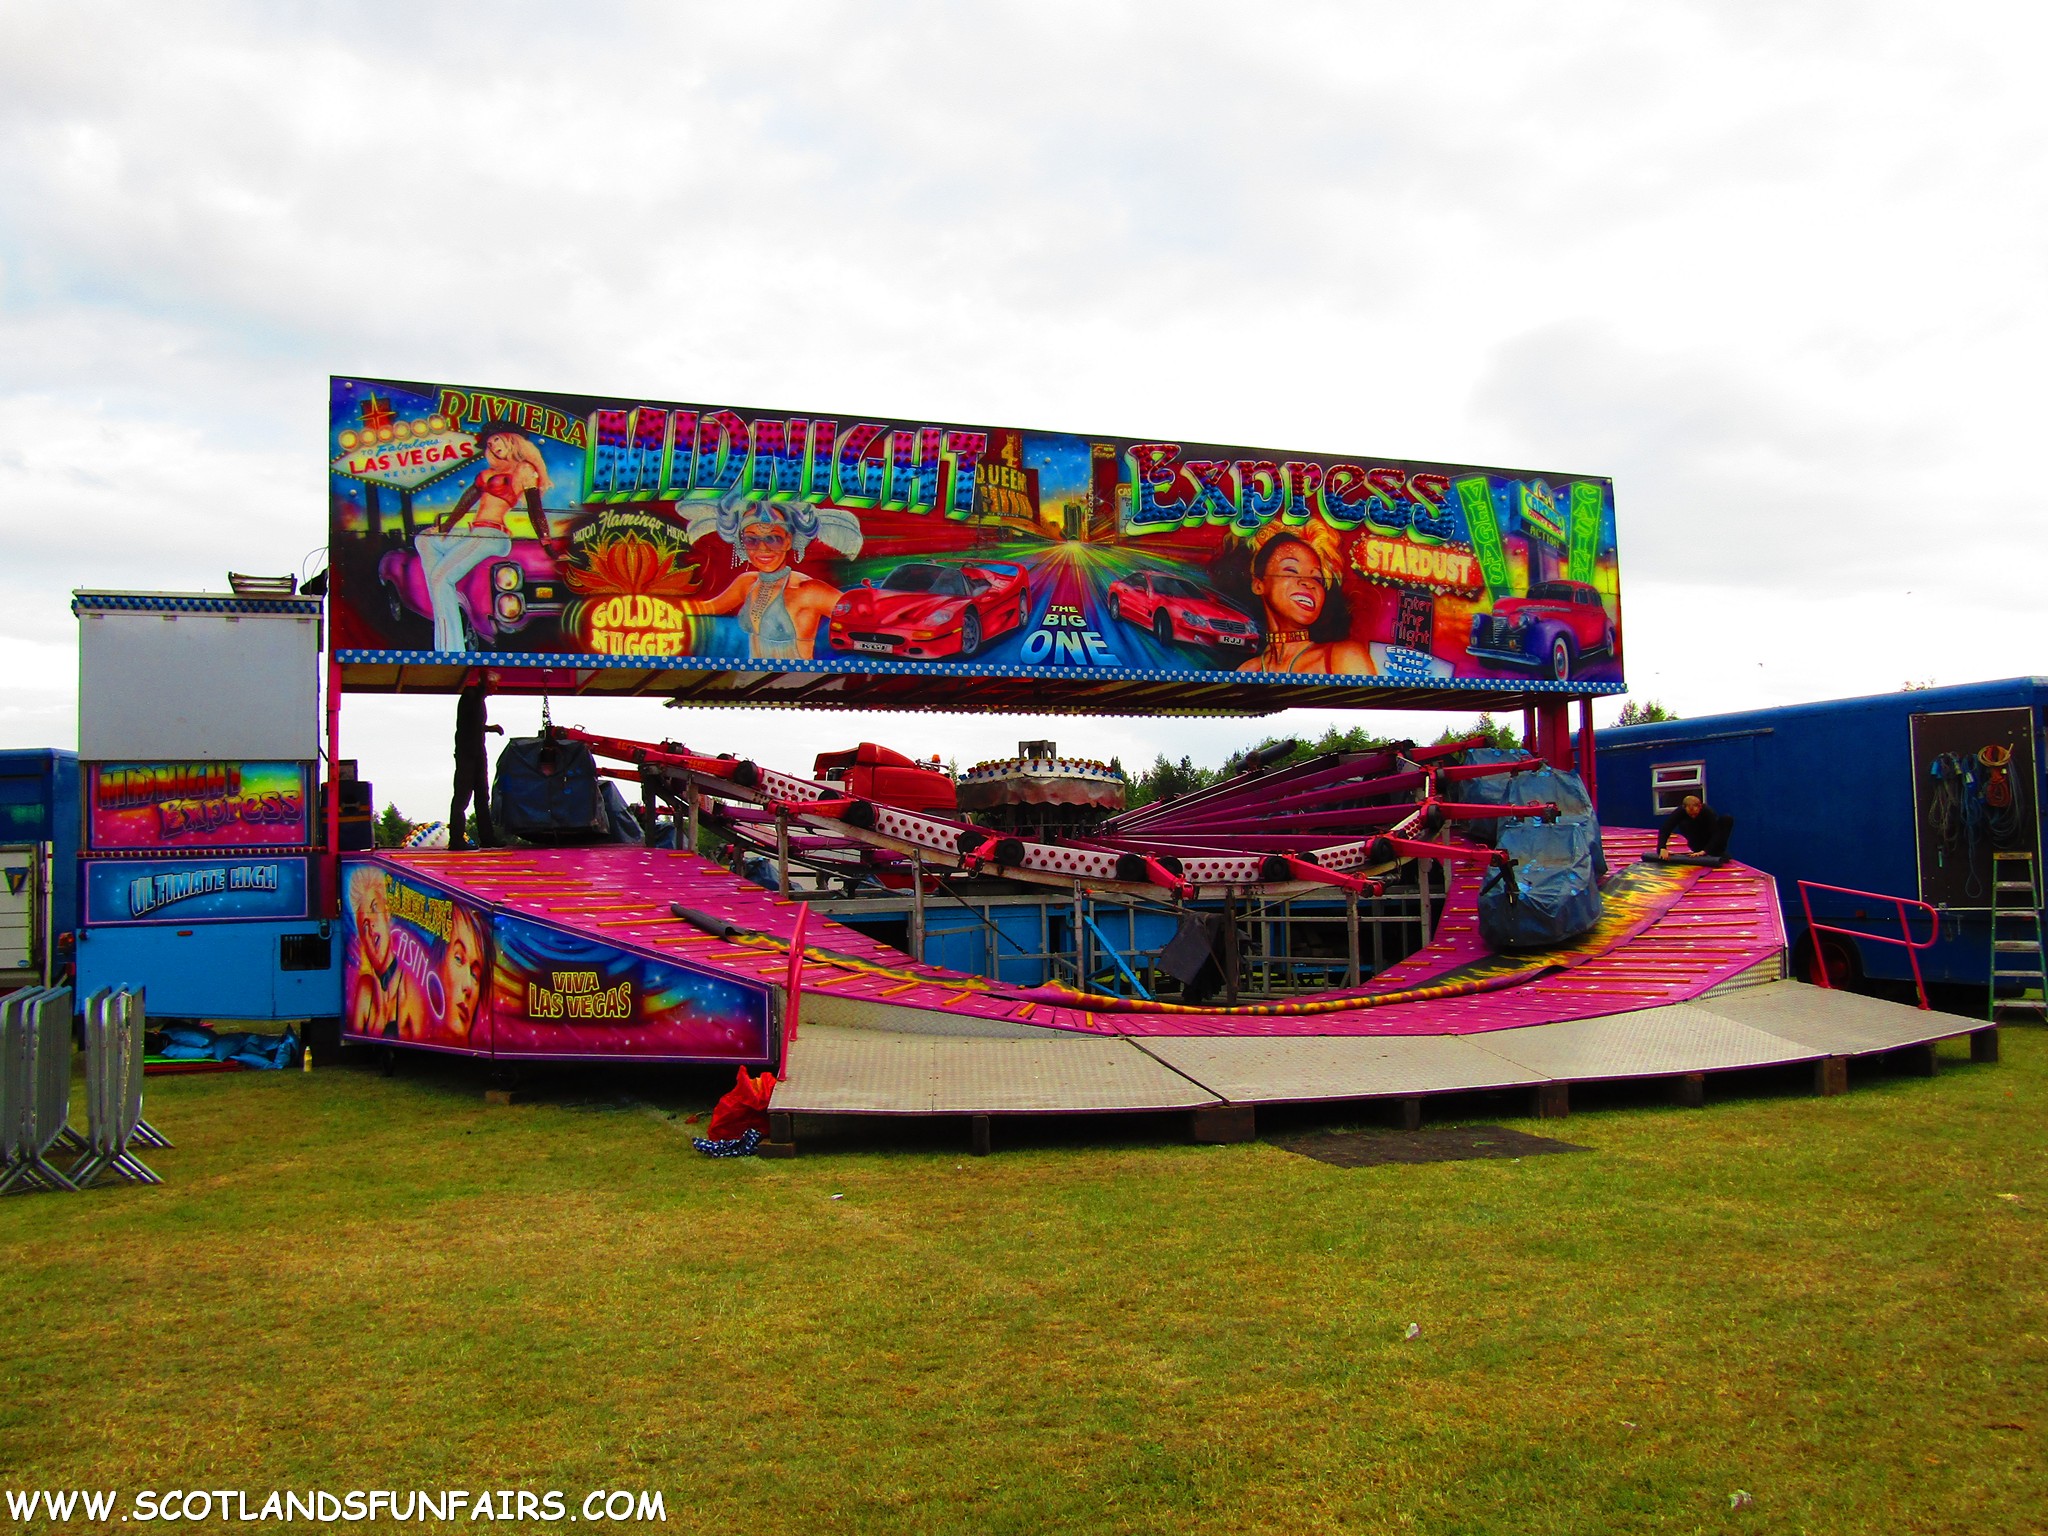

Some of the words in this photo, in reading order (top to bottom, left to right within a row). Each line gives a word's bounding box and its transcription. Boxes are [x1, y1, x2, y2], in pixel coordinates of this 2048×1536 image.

[437, 389, 588, 450] RIVIERA
[349, 454, 391, 475] LAS
[396, 441, 475, 468] VEGAS
[375, 438, 441, 457] Fabulous
[583, 405, 988, 520] MIDNIGHT
[384, 465, 437, 479] NEVADA
[598, 509, 665, 536] Flamingo
[1461, 482, 1505, 585] VEGAS
[1572, 485, 1599, 584] CASINO
[1366, 539, 1472, 585] STARDUST
[591, 594, 684, 630] GOLDEN
[1042, 613, 1087, 627] BIG
[1051, 605, 1078, 613] THE
[591, 628, 685, 656] NUGGET
[1020, 629, 1123, 667] ONE
[1395, 655, 1423, 667] THE
[130, 869, 226, 917] ULTIMATE
[230, 865, 278, 890] HIGH
[390, 928, 446, 1020] CASINO
[552, 971, 600, 993] VIVA
[529, 982, 566, 1019] LAS
[567, 982, 632, 1019] VEGAS
